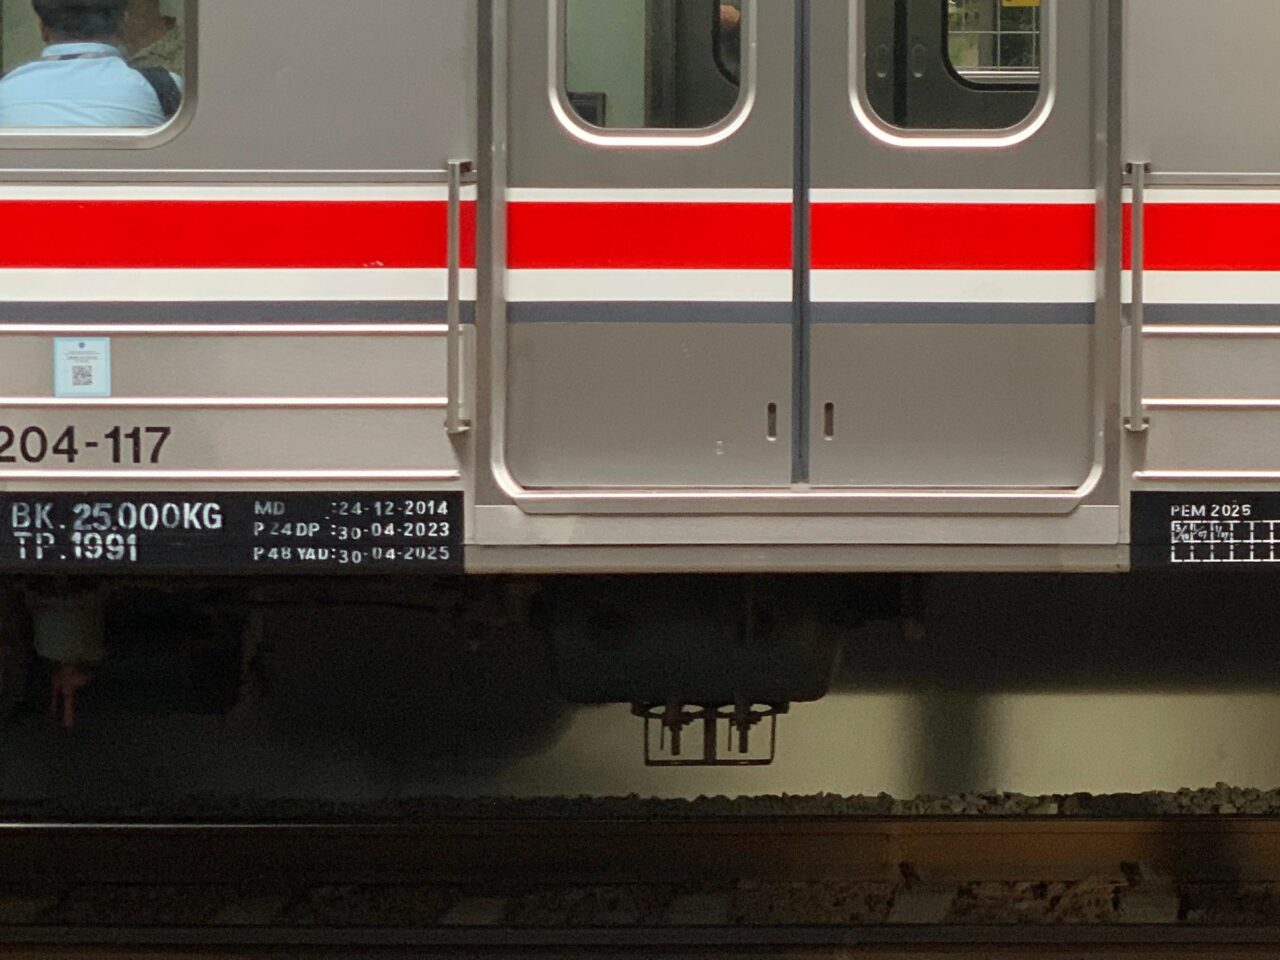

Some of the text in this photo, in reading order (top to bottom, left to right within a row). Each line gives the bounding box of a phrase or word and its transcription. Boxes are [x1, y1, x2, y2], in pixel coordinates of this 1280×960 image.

[0, 425, 172, 464] 204-117
[253, 500, 286, 516] MD
[1170, 504, 1252, 518] PEM 2025
[71, 531, 138, 562] 1991
